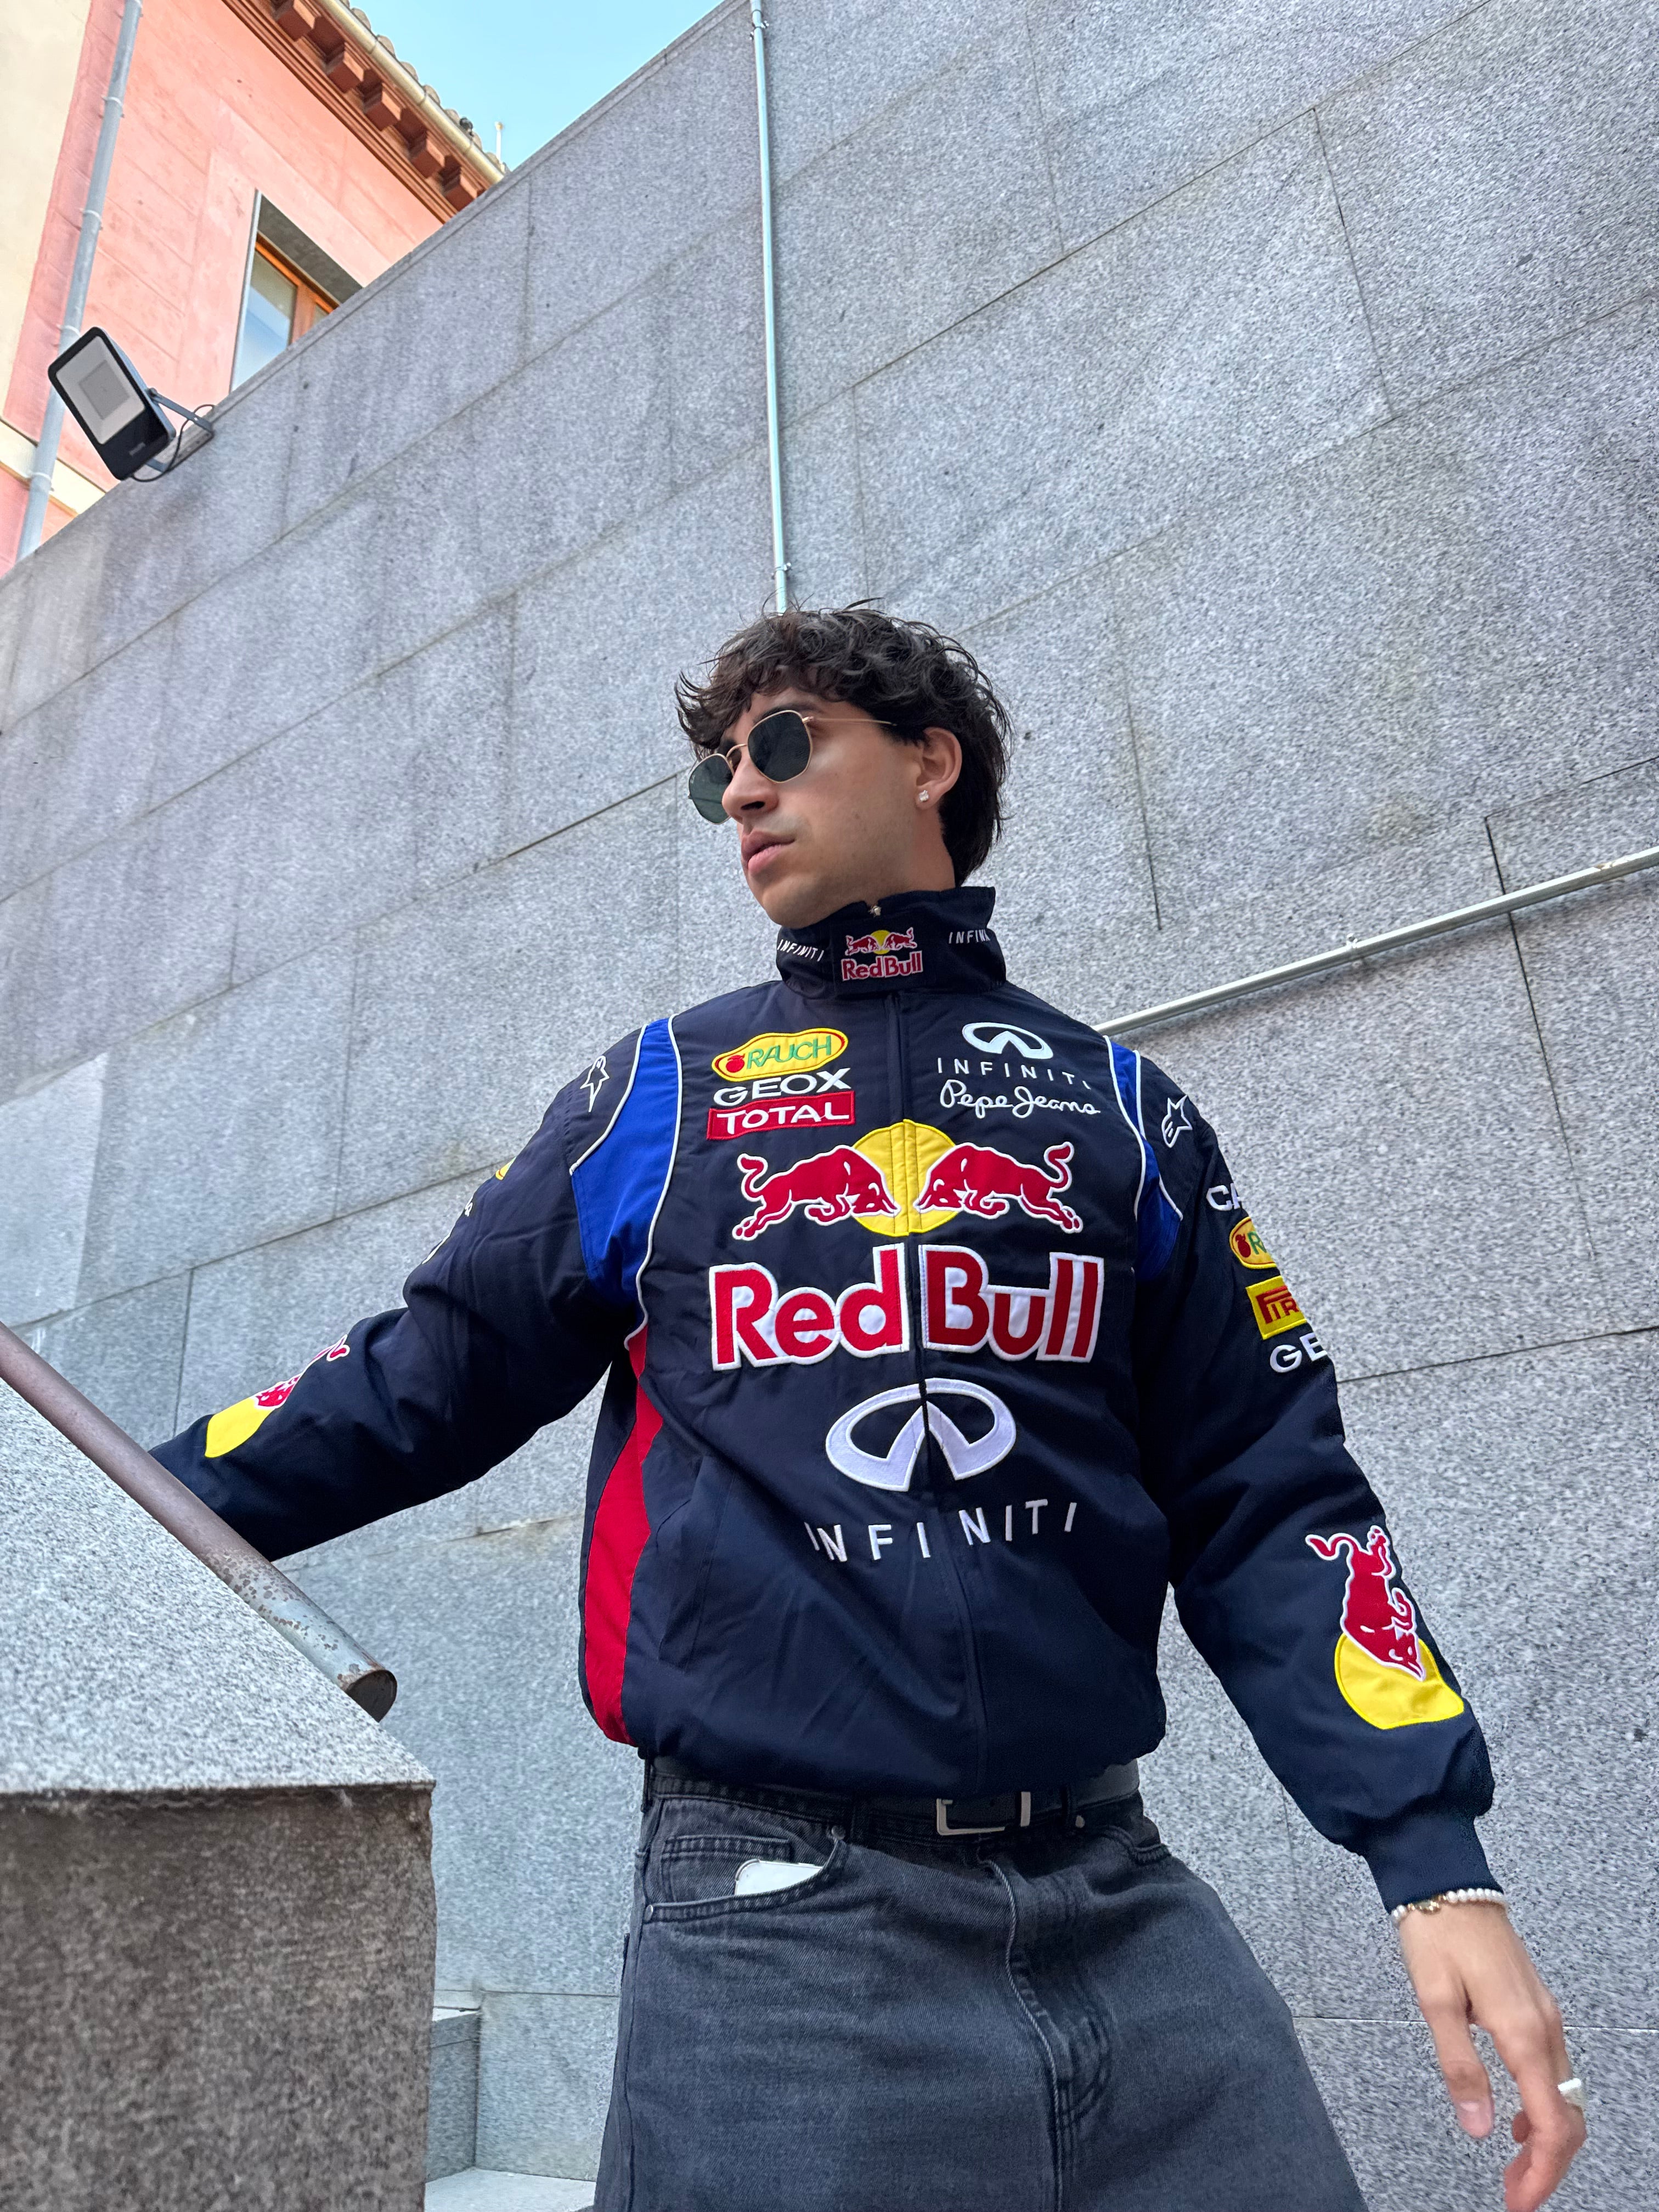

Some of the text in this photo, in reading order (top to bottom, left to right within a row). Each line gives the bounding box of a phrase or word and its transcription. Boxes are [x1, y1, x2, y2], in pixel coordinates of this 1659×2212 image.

[777, 939, 825, 962] INFINITI
[747, 1035, 832, 1069] RAUCH
[713, 1067, 852, 1107] GEOX
[937, 1057, 1092, 1090] INFINITI
[940, 1079, 1101, 1119] Pepe Jeans
[716, 1102, 850, 1135] TOTAL
[710, 1243, 1104, 1370] Red Bull
[804, 1499, 1077, 1562] INFINITI
